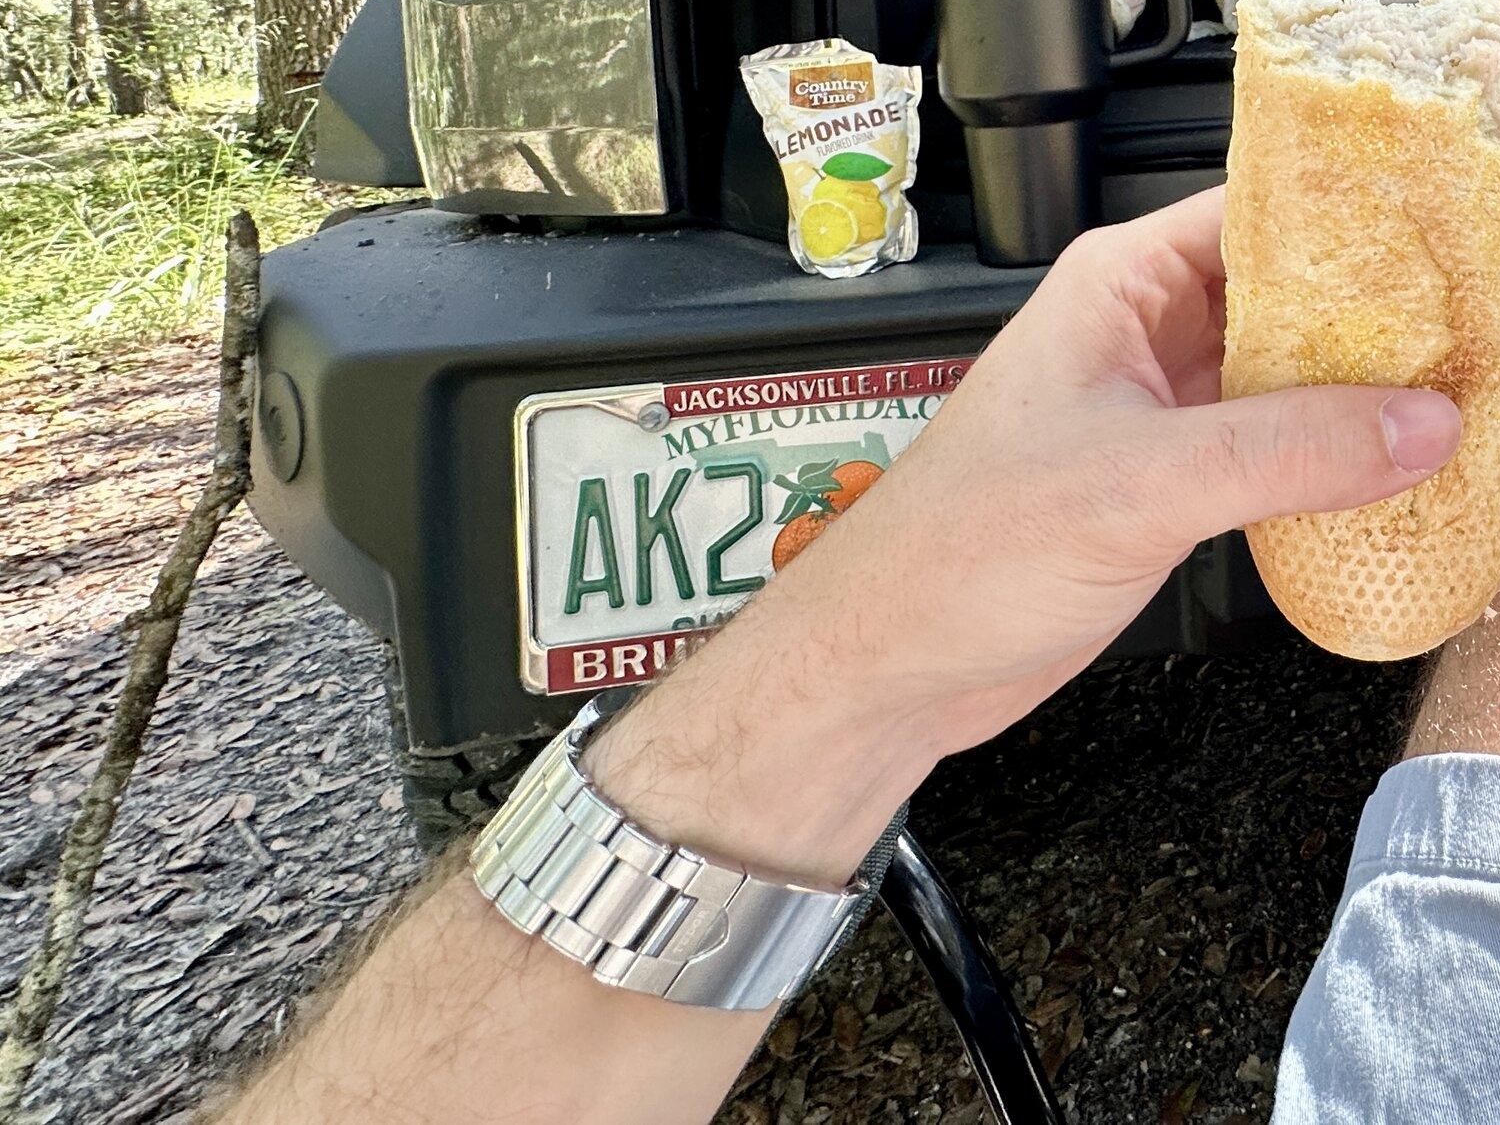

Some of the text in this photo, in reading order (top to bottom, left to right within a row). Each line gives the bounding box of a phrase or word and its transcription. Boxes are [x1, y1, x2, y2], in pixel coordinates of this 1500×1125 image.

[795, 78, 869, 96] Country
[809, 92, 856, 107] Time
[776, 100, 902, 160] LEMONADE
[816, 131, 876, 157] FLAVORED DRINK
[673, 373, 879, 413] JACKSONVILLE,
[564, 460, 767, 615] AK2
[573, 636, 707, 684] BRU
